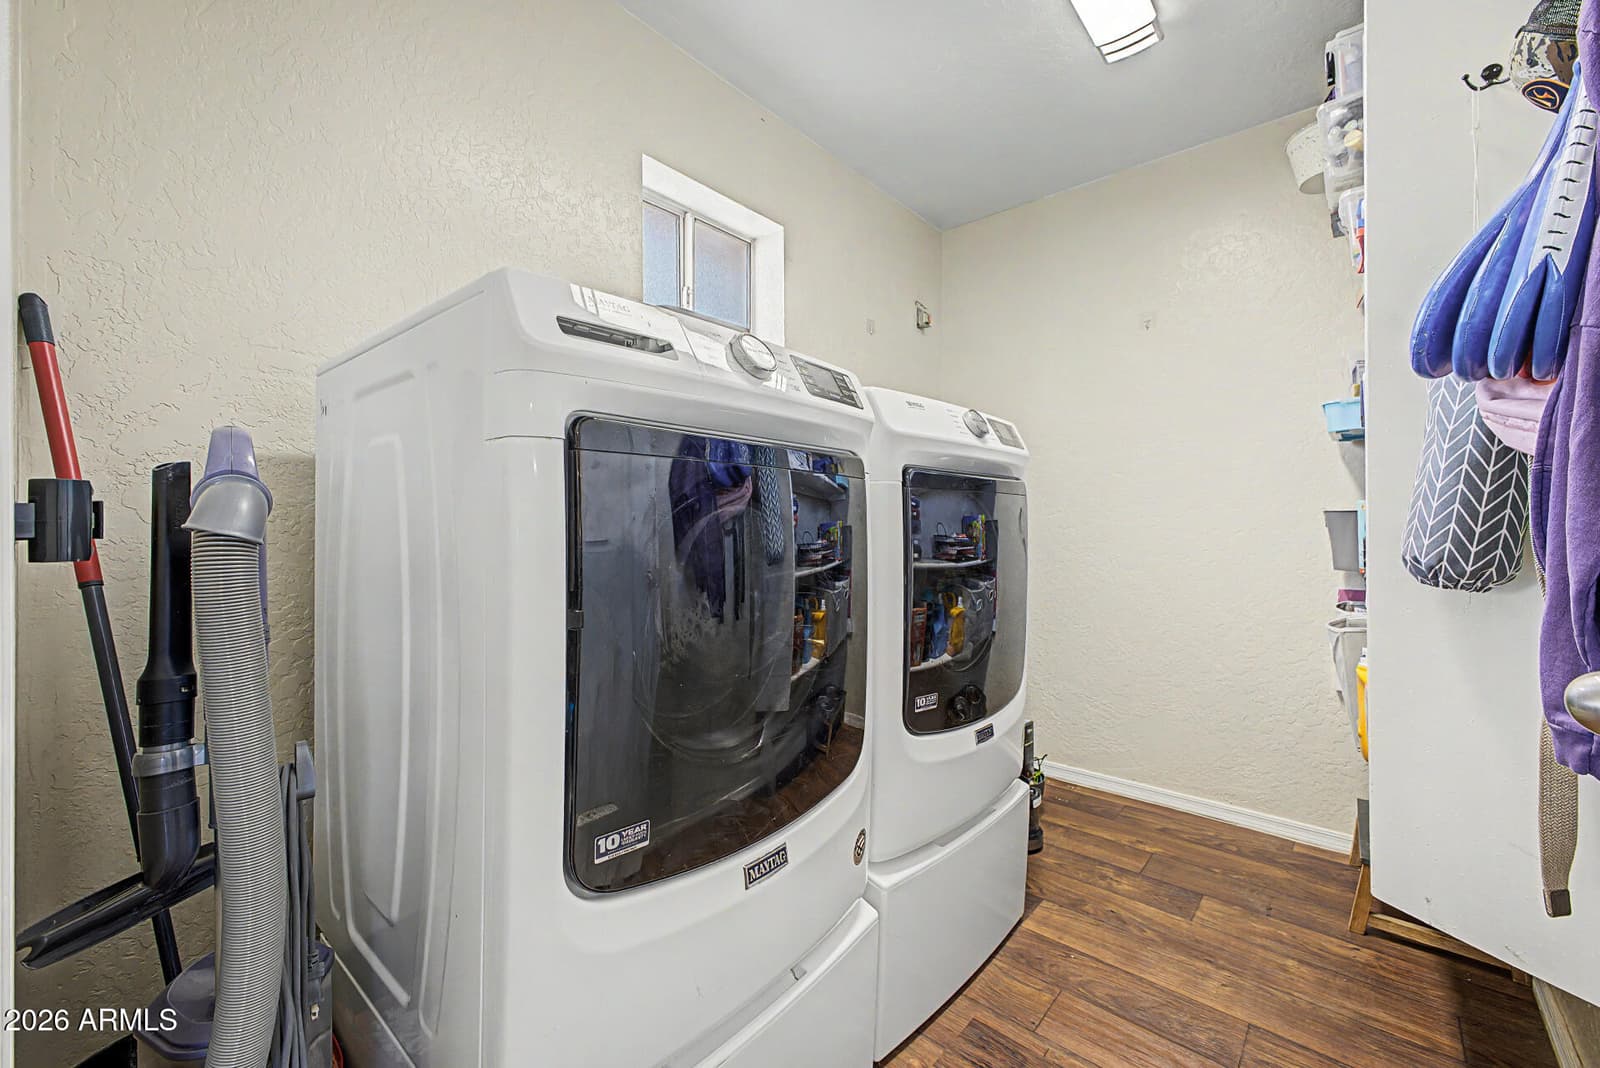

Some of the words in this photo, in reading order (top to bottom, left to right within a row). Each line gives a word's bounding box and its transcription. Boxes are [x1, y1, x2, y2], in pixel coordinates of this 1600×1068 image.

[917, 698, 926, 708] 10
[597, 833, 621, 854] 10
[622, 824, 647, 838] YEAR
[748, 850, 787, 883] MAYTAG
